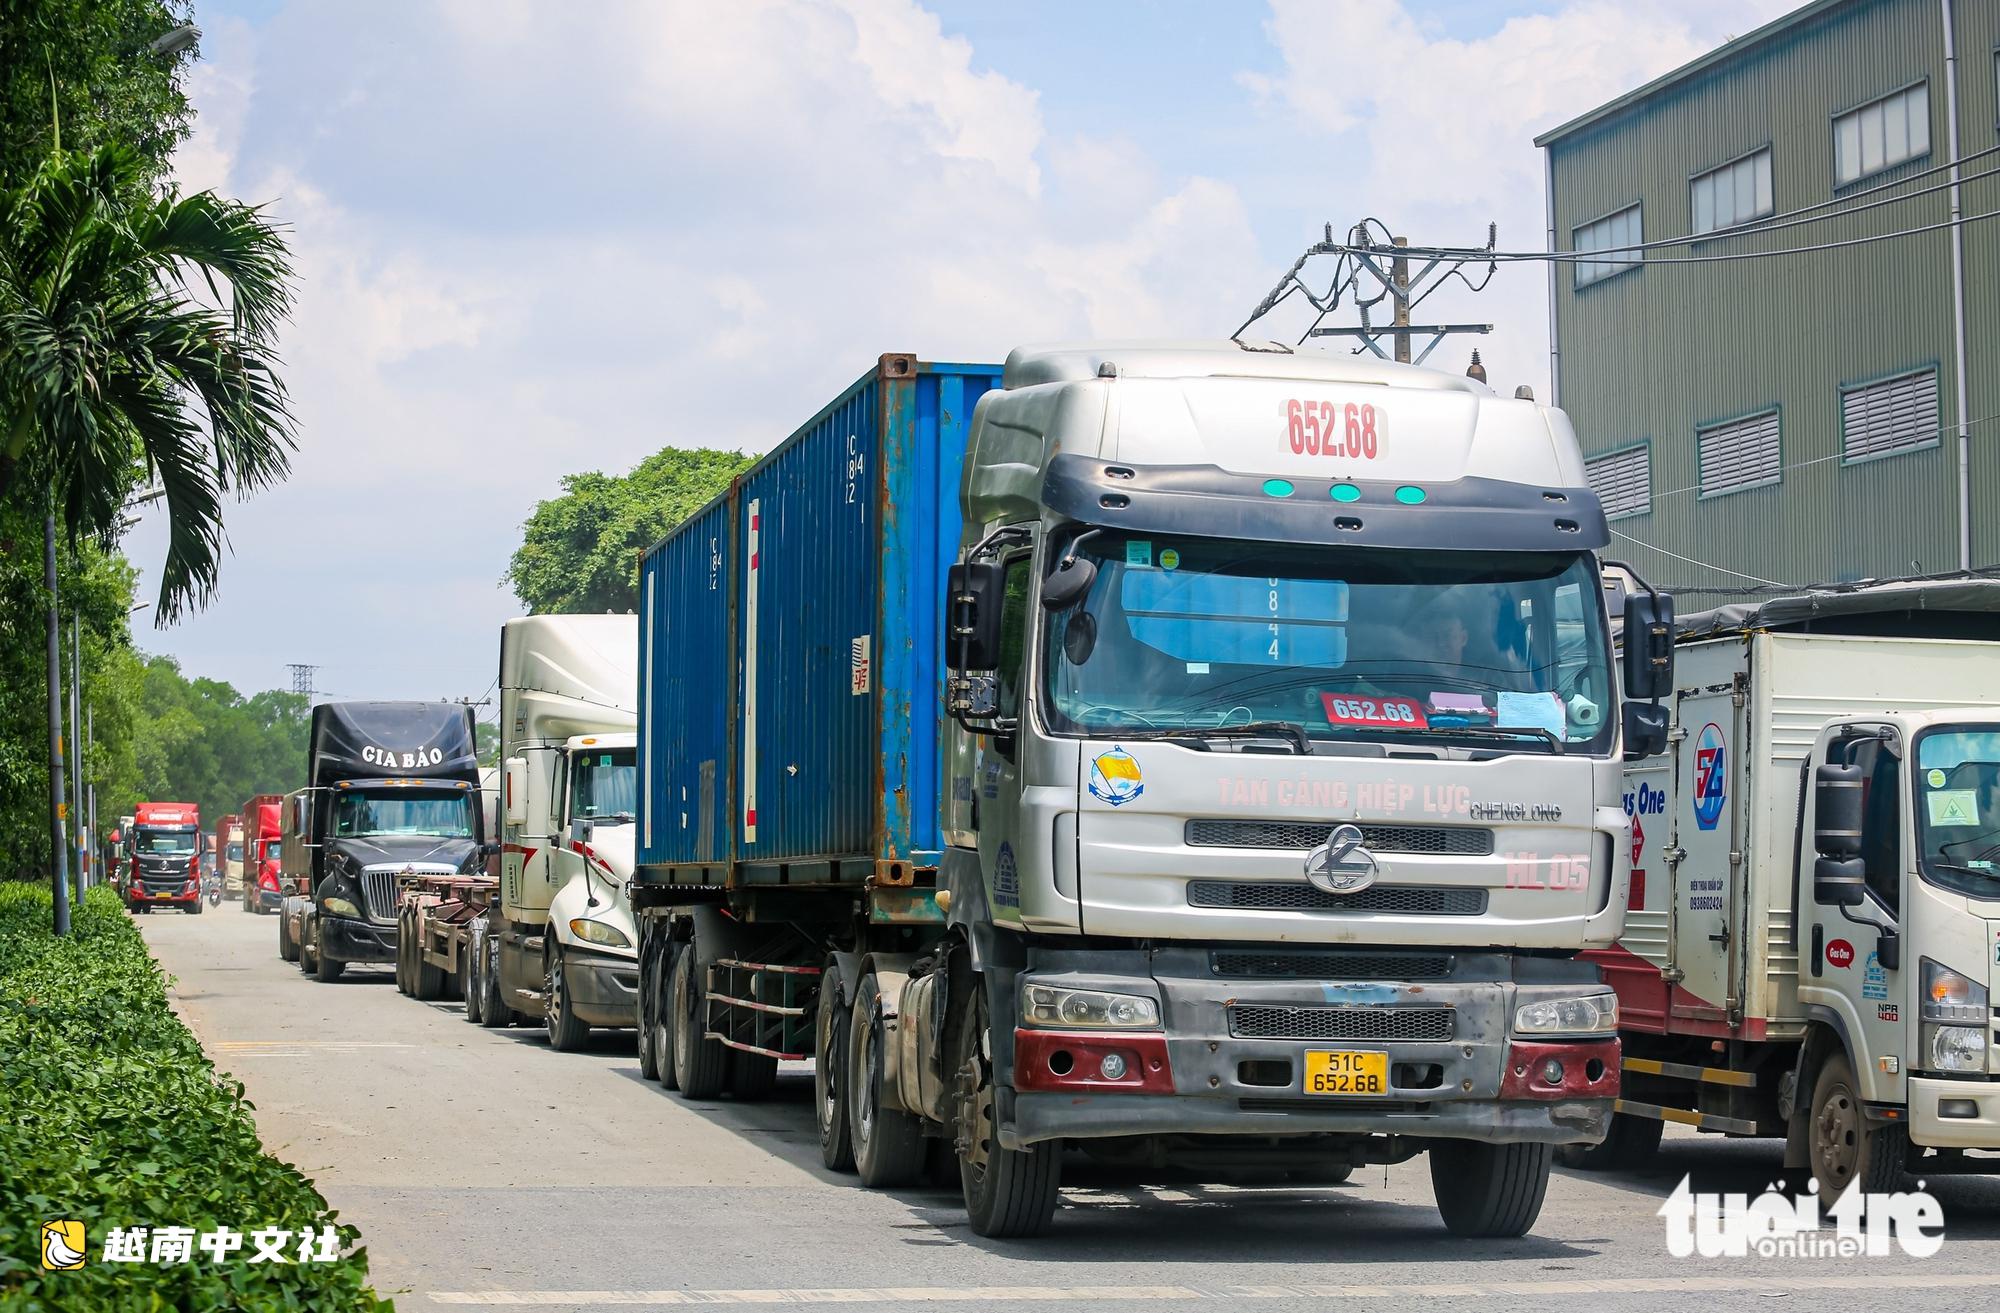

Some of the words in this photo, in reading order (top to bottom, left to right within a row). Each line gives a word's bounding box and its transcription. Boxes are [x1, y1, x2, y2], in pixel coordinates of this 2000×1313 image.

[1287, 399, 1377, 460] 652.68
[1332, 699, 1415, 723] 652.68
[362, 745, 398, 768] GIA
[402, 745, 443, 768] BẢO
[1277, 772, 1349, 809] CẢNG
[1357, 777, 1415, 817] HIỆP
[1423, 783, 1472, 818] LỰC
[1638, 782, 1665, 816] One
[1470, 801, 1562, 822] CHENGLONG
[1504, 852, 1545, 892] HL
[1550, 853, 1591, 893] 05
[1878, 1004, 1898, 1013] NPR
[1878, 1012, 1898, 1021] 400
[1329, 1054, 1364, 1072] 51C
[1314, 1074, 1379, 1093] 652.68
